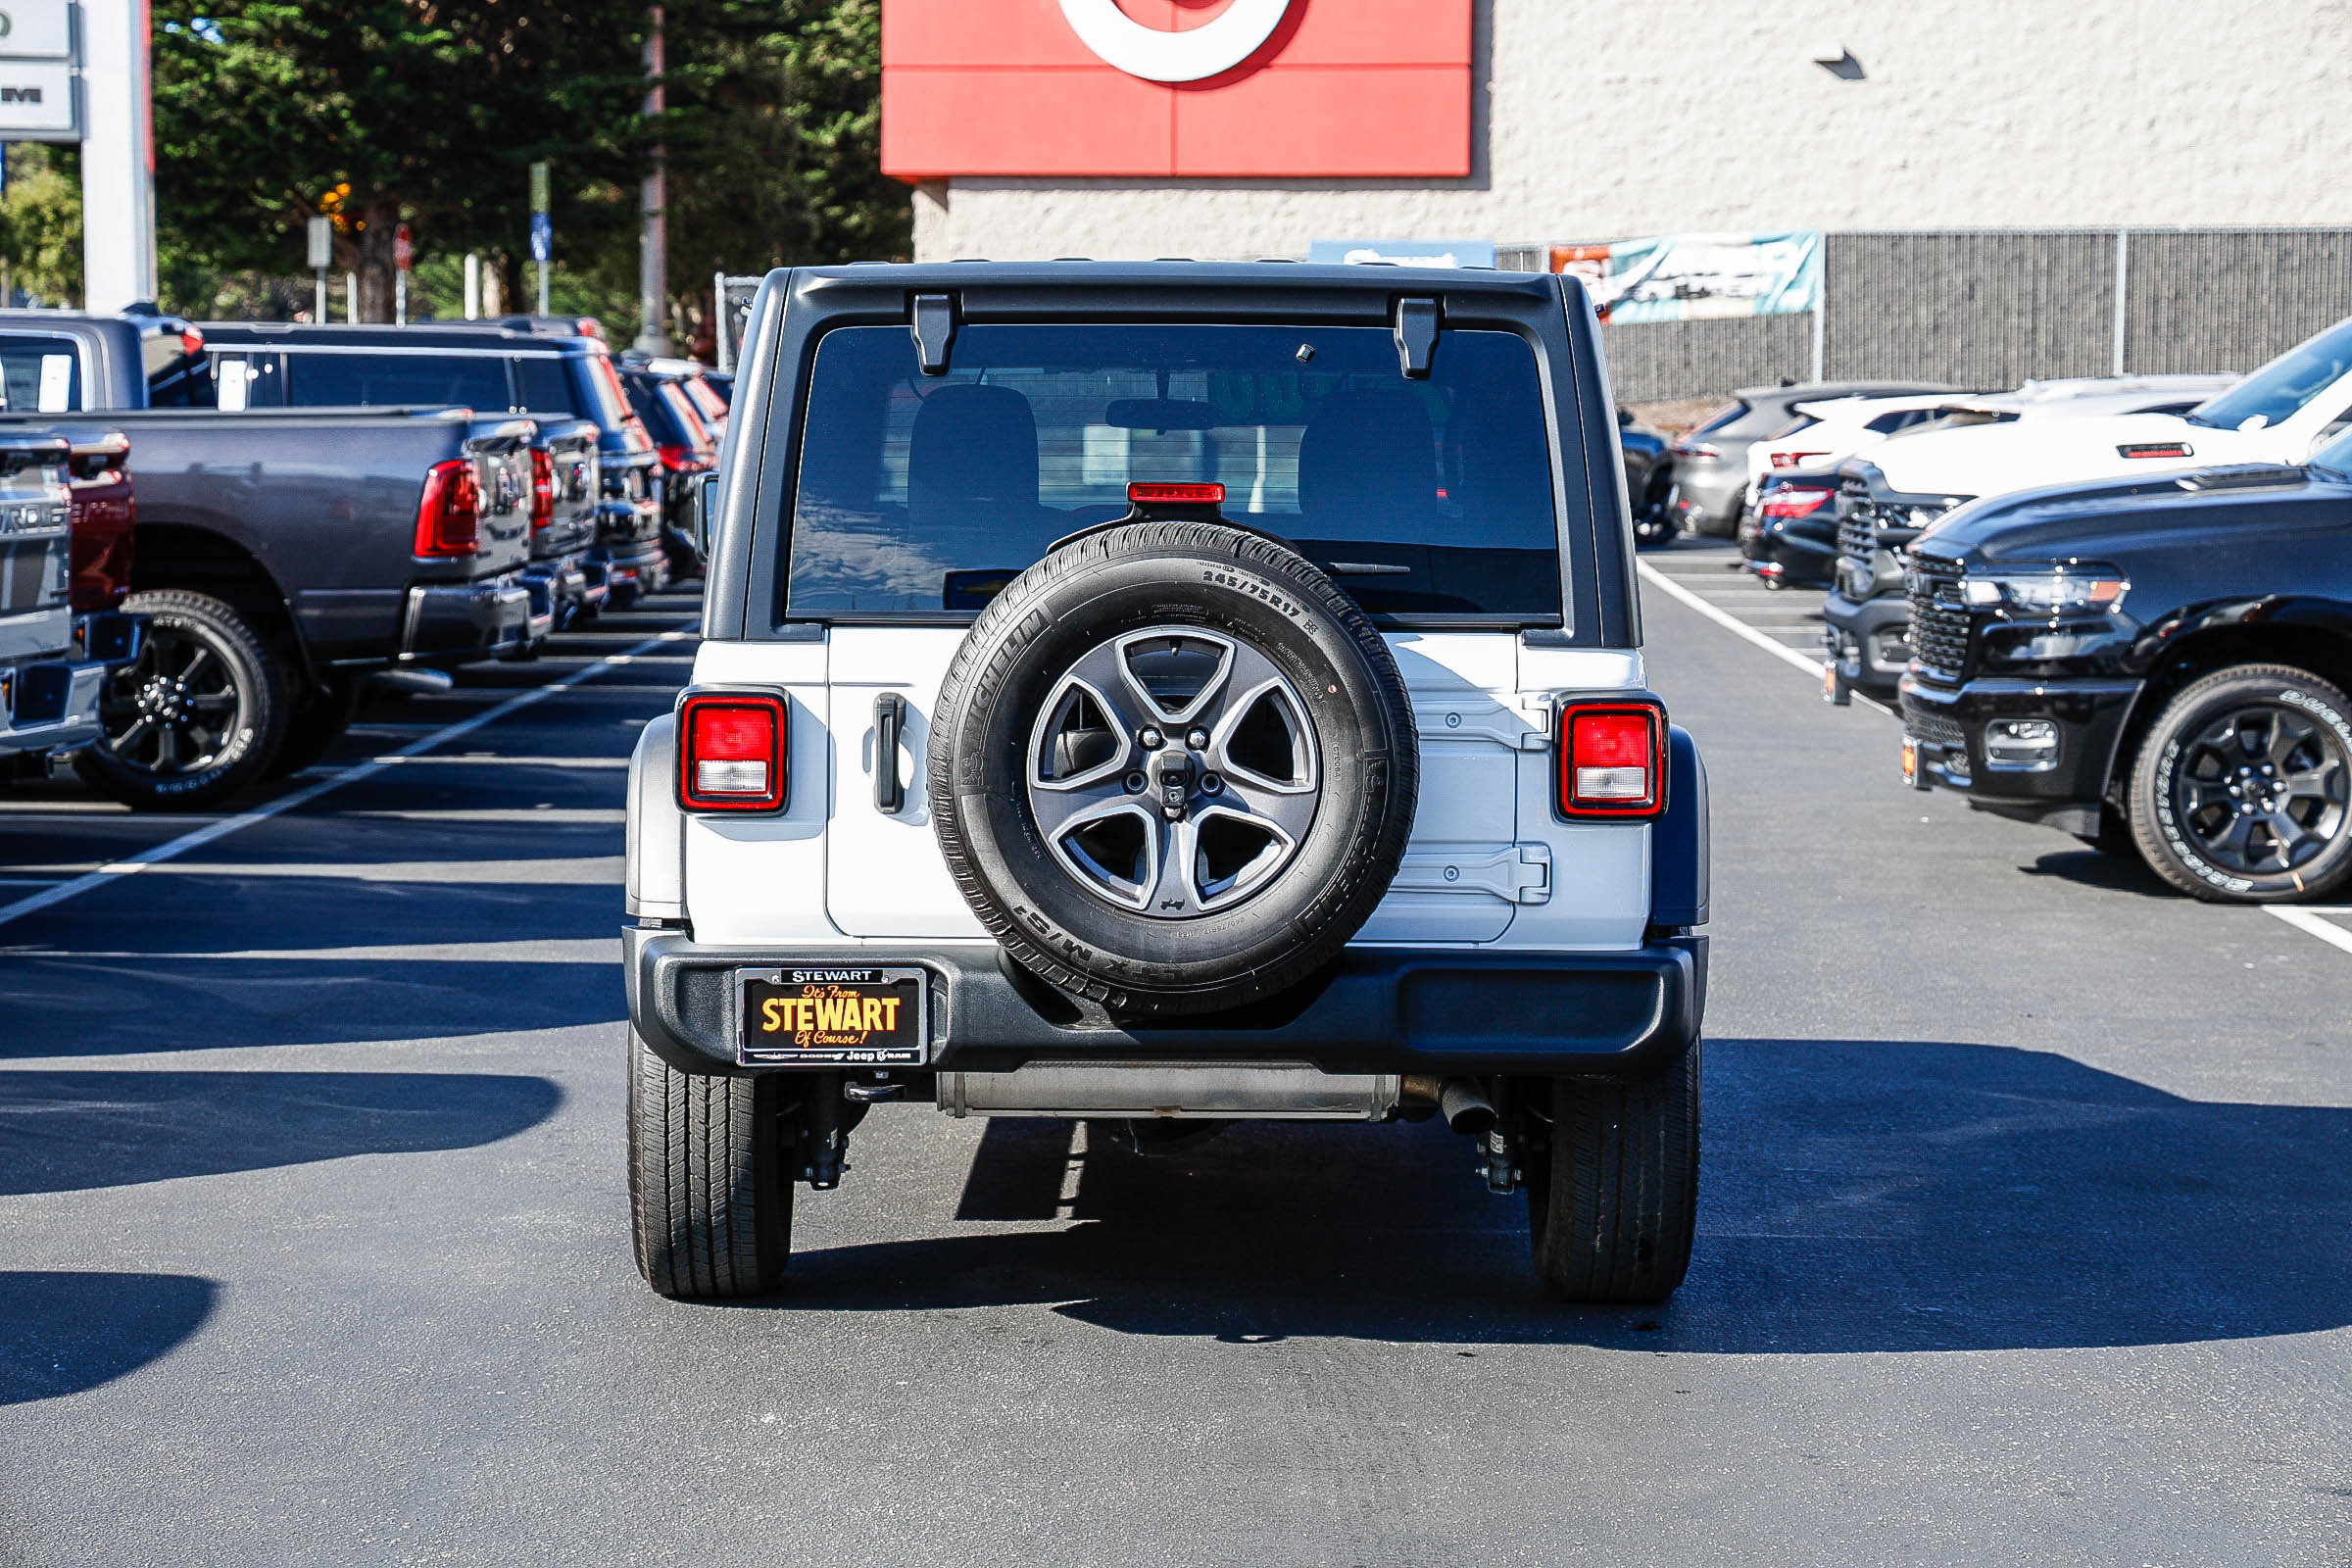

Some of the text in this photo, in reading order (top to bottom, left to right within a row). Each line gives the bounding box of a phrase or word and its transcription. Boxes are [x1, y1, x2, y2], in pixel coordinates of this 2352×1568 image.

[1202, 570, 1300, 617] 245/75R17
[962, 611, 1043, 742] MICHELIN
[792, 970, 872, 982] STEWART
[802, 985, 860, 999] It's From
[761, 998, 901, 1032] STEWART
[795, 1030, 811, 1048] Of
[847, 1052, 875, 1061] Jeep
